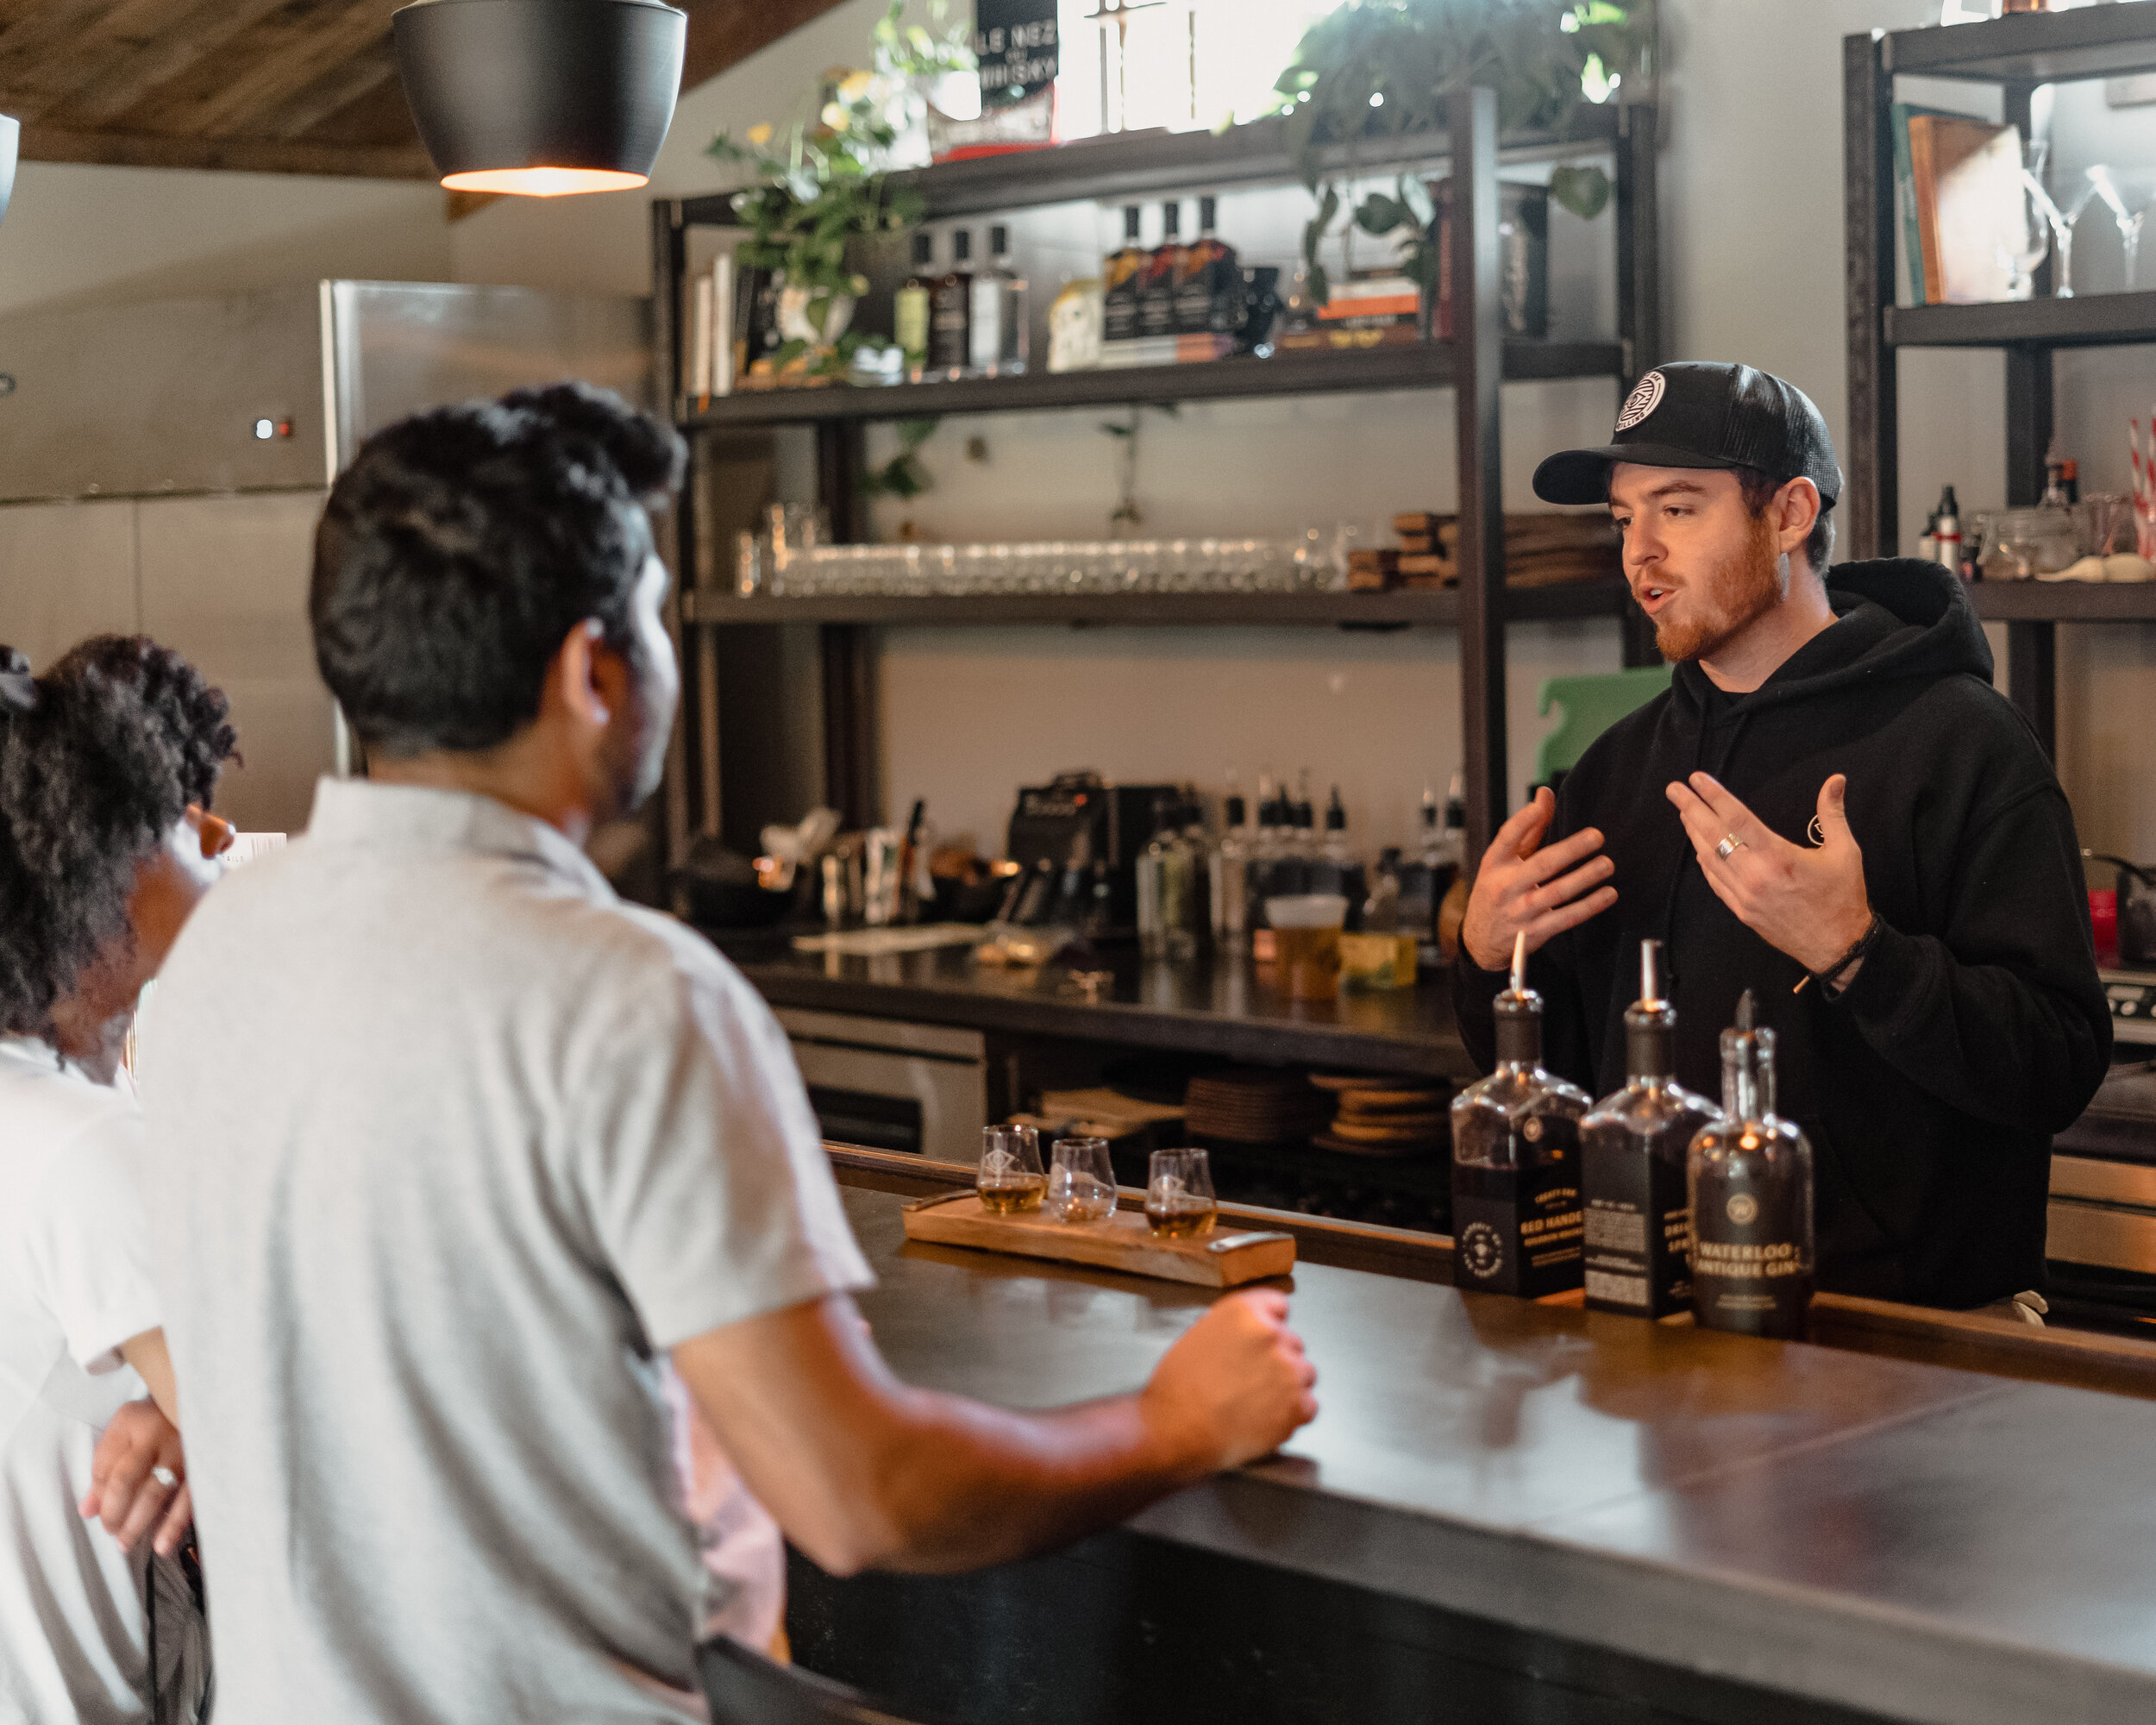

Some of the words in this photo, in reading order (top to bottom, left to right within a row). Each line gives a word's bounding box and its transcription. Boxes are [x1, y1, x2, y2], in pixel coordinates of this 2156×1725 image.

[975, 28, 1006, 56] LE
[1011, 20, 1057, 49] NEZ
[1520, 1219, 1544, 1235] RED
[1545, 1211, 1583, 1229] HANDE
[1699, 1242, 1794, 1260] WATERLOO
[1696, 1258, 1763, 1278] ANTIQUE
[1764, 1260, 1796, 1277] GIN
